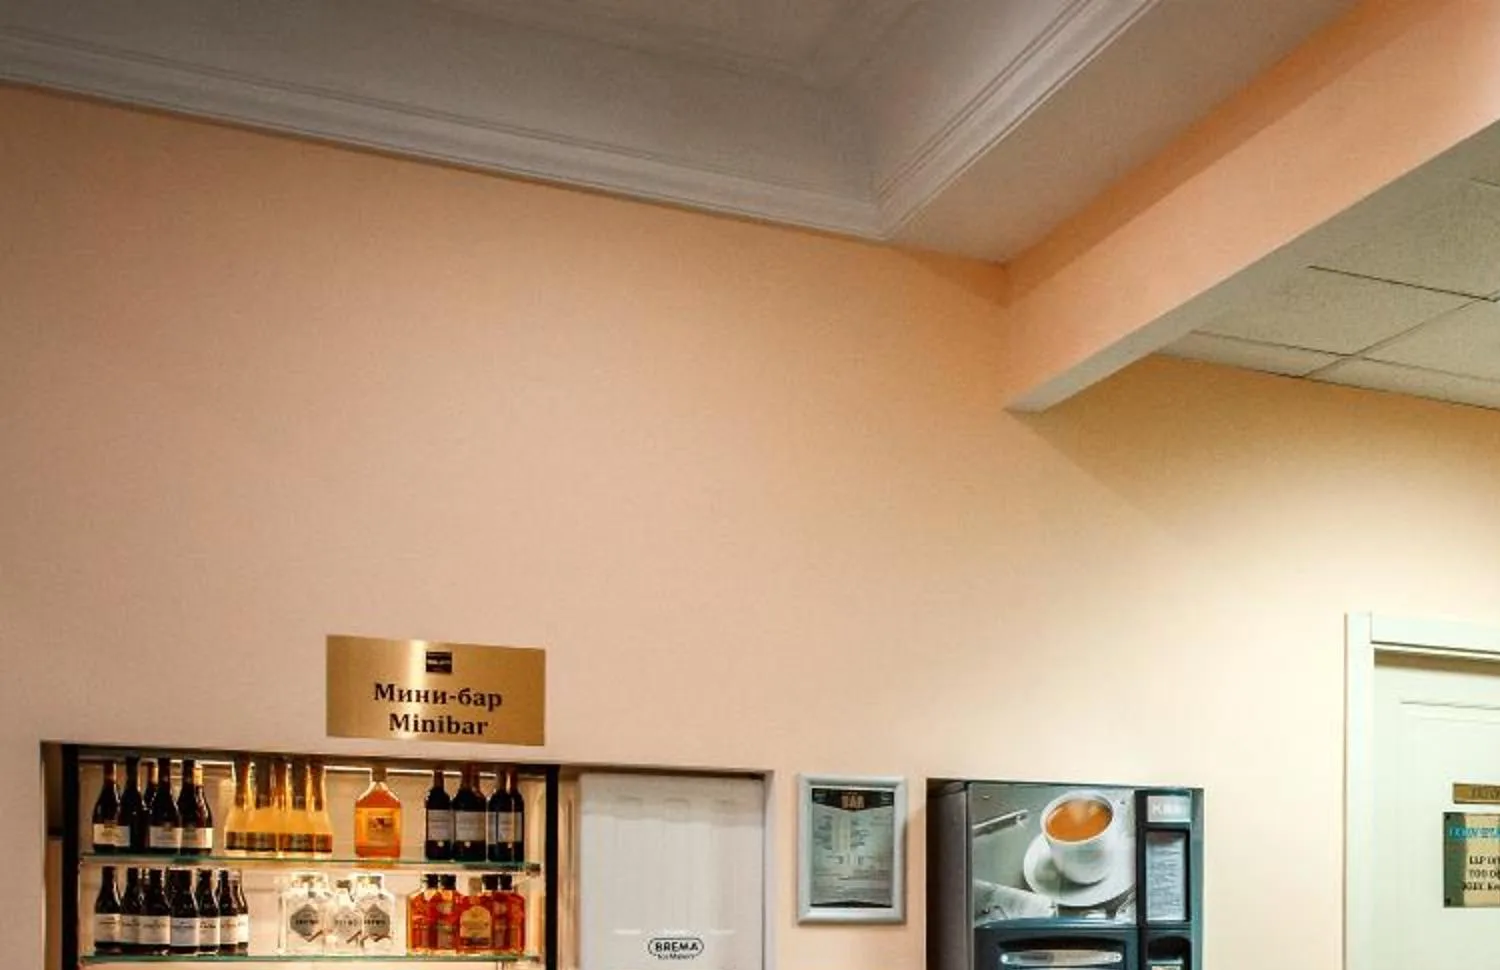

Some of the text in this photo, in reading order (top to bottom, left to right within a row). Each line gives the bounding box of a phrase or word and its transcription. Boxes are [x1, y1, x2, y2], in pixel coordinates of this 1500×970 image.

[374, 683, 503, 712] Мини-бар
[389, 713, 489, 736] Minibar
[655, 940, 699, 952] BREMA
